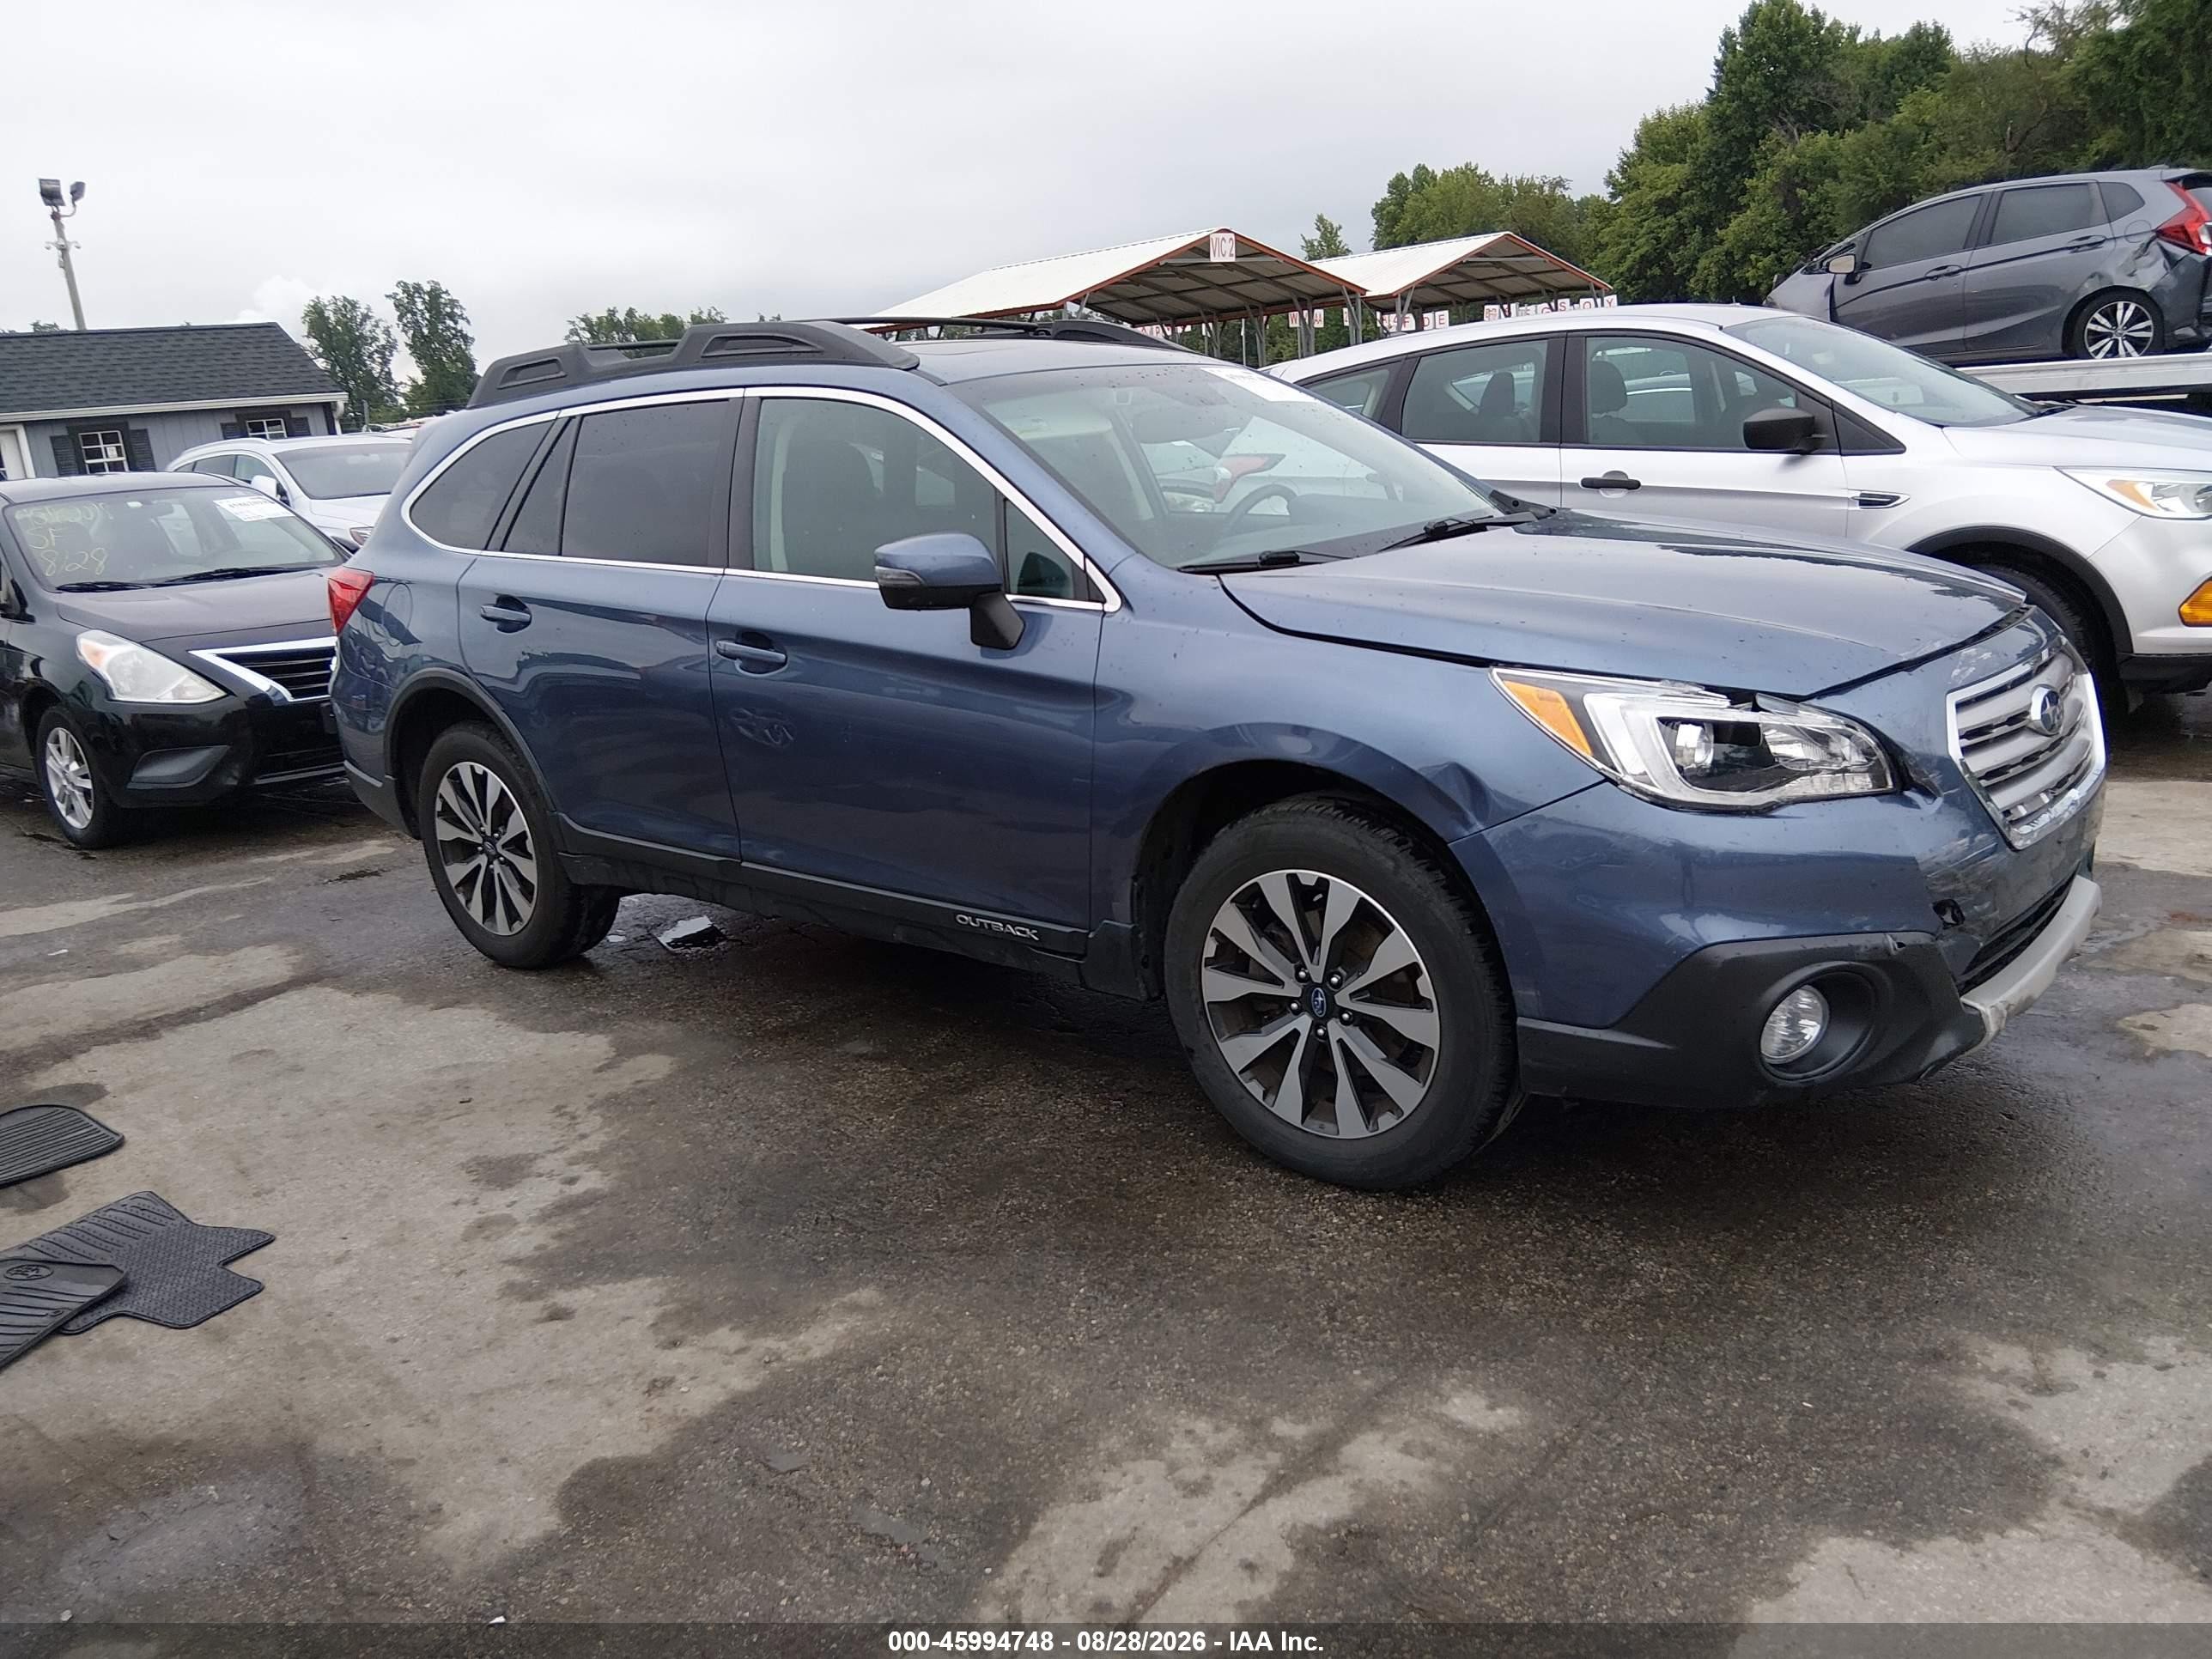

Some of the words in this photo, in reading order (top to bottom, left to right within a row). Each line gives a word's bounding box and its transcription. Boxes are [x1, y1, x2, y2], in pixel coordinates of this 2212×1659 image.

[1210, 236, 1227, 258] VIC
[1228, 236, 1235, 258] 2
[1438, 314, 1446, 325] E
[955, 914, 1040, 941] OUTBACK
